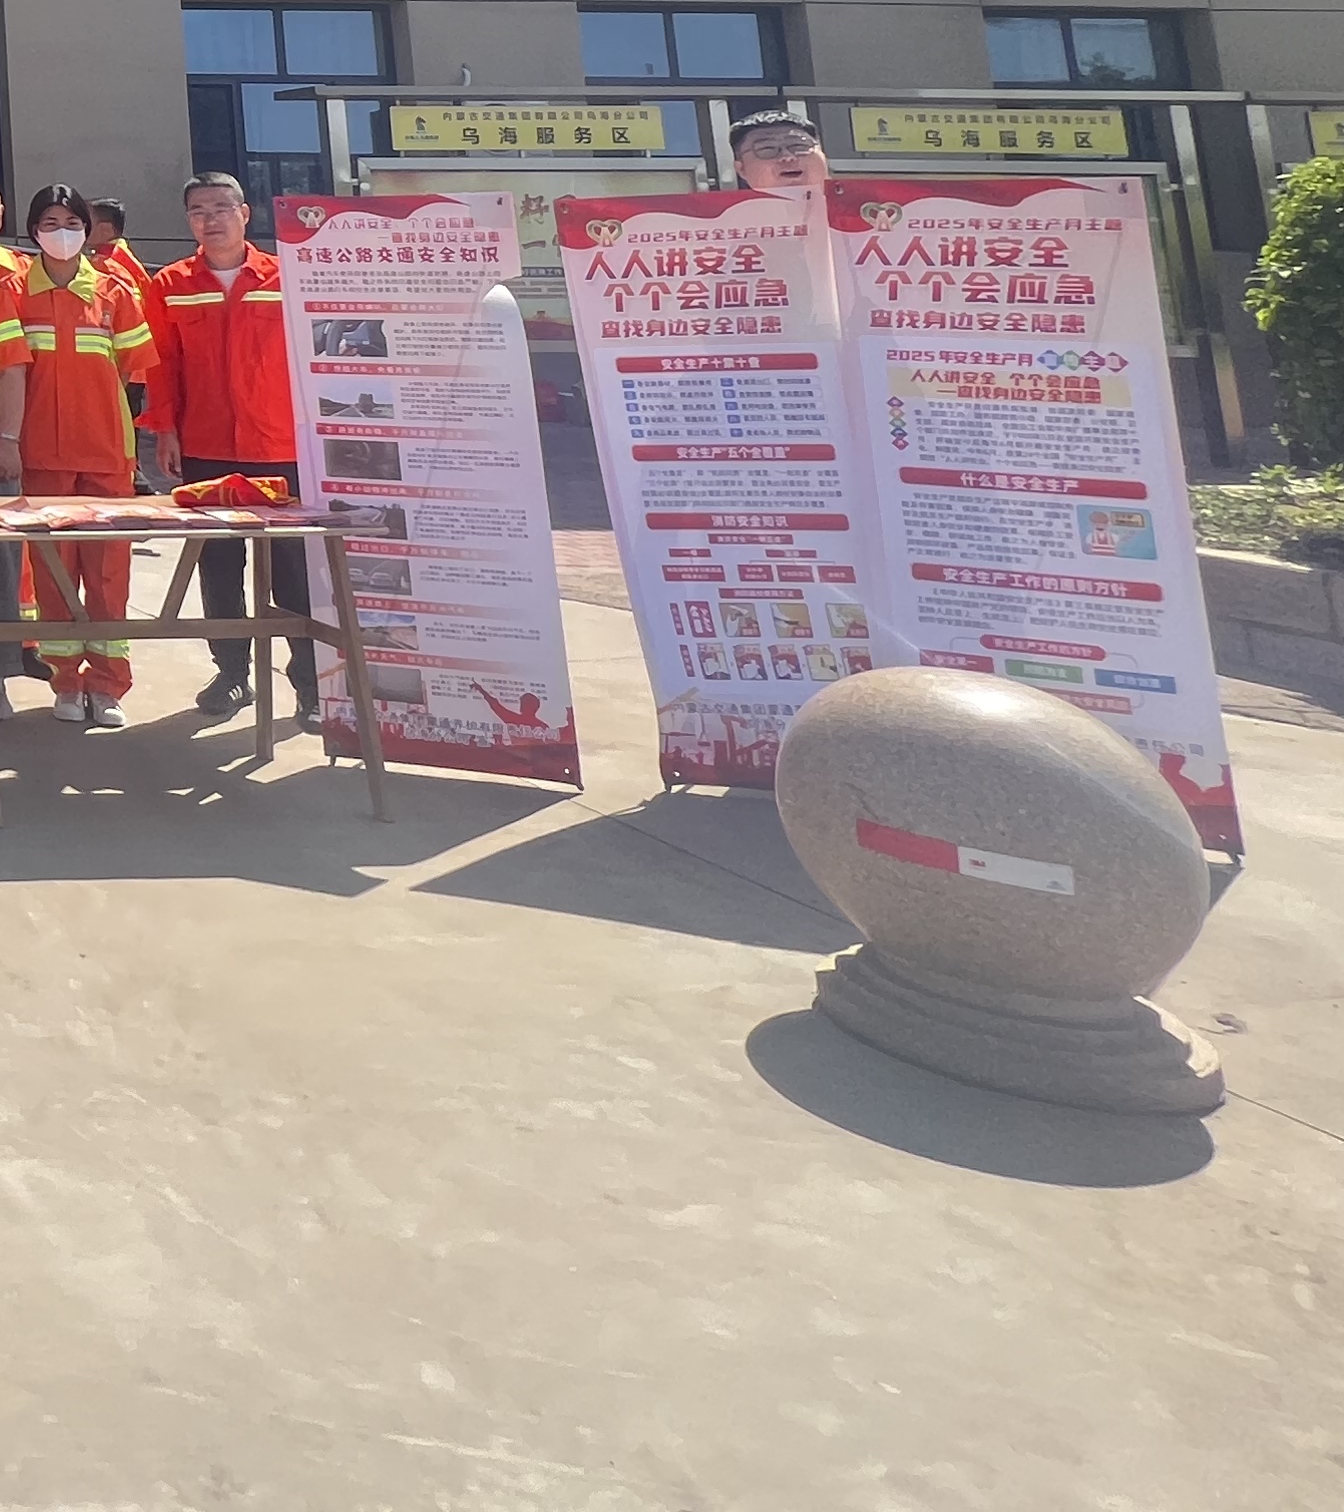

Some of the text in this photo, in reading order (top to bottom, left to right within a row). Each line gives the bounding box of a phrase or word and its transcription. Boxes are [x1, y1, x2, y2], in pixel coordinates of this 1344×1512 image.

[461, 126, 631, 145] 乌海服务区
[924, 129, 1094, 148] 乌海服务区
[627, 224, 809, 244] 2025年安全生产月主题
[907, 217, 1123, 231] 2025年安全生产月主题
[296, 246, 501, 264] 高速公路交通安全知识
[584, 244, 766, 281] 人人讲安全
[854, 235, 1070, 268] 人人讲安全
[603, 278, 789, 313] 个个会应急
[874, 270, 1096, 305] 个个会应急
[601, 315, 783, 338] 查找身边安全隐患
[869, 309, 1086, 334] 查找身边安全隐患
[910, 368, 1101, 390] 人人讲安全 个个会应急
[960, 472, 1080, 492] 什么是安全生产
